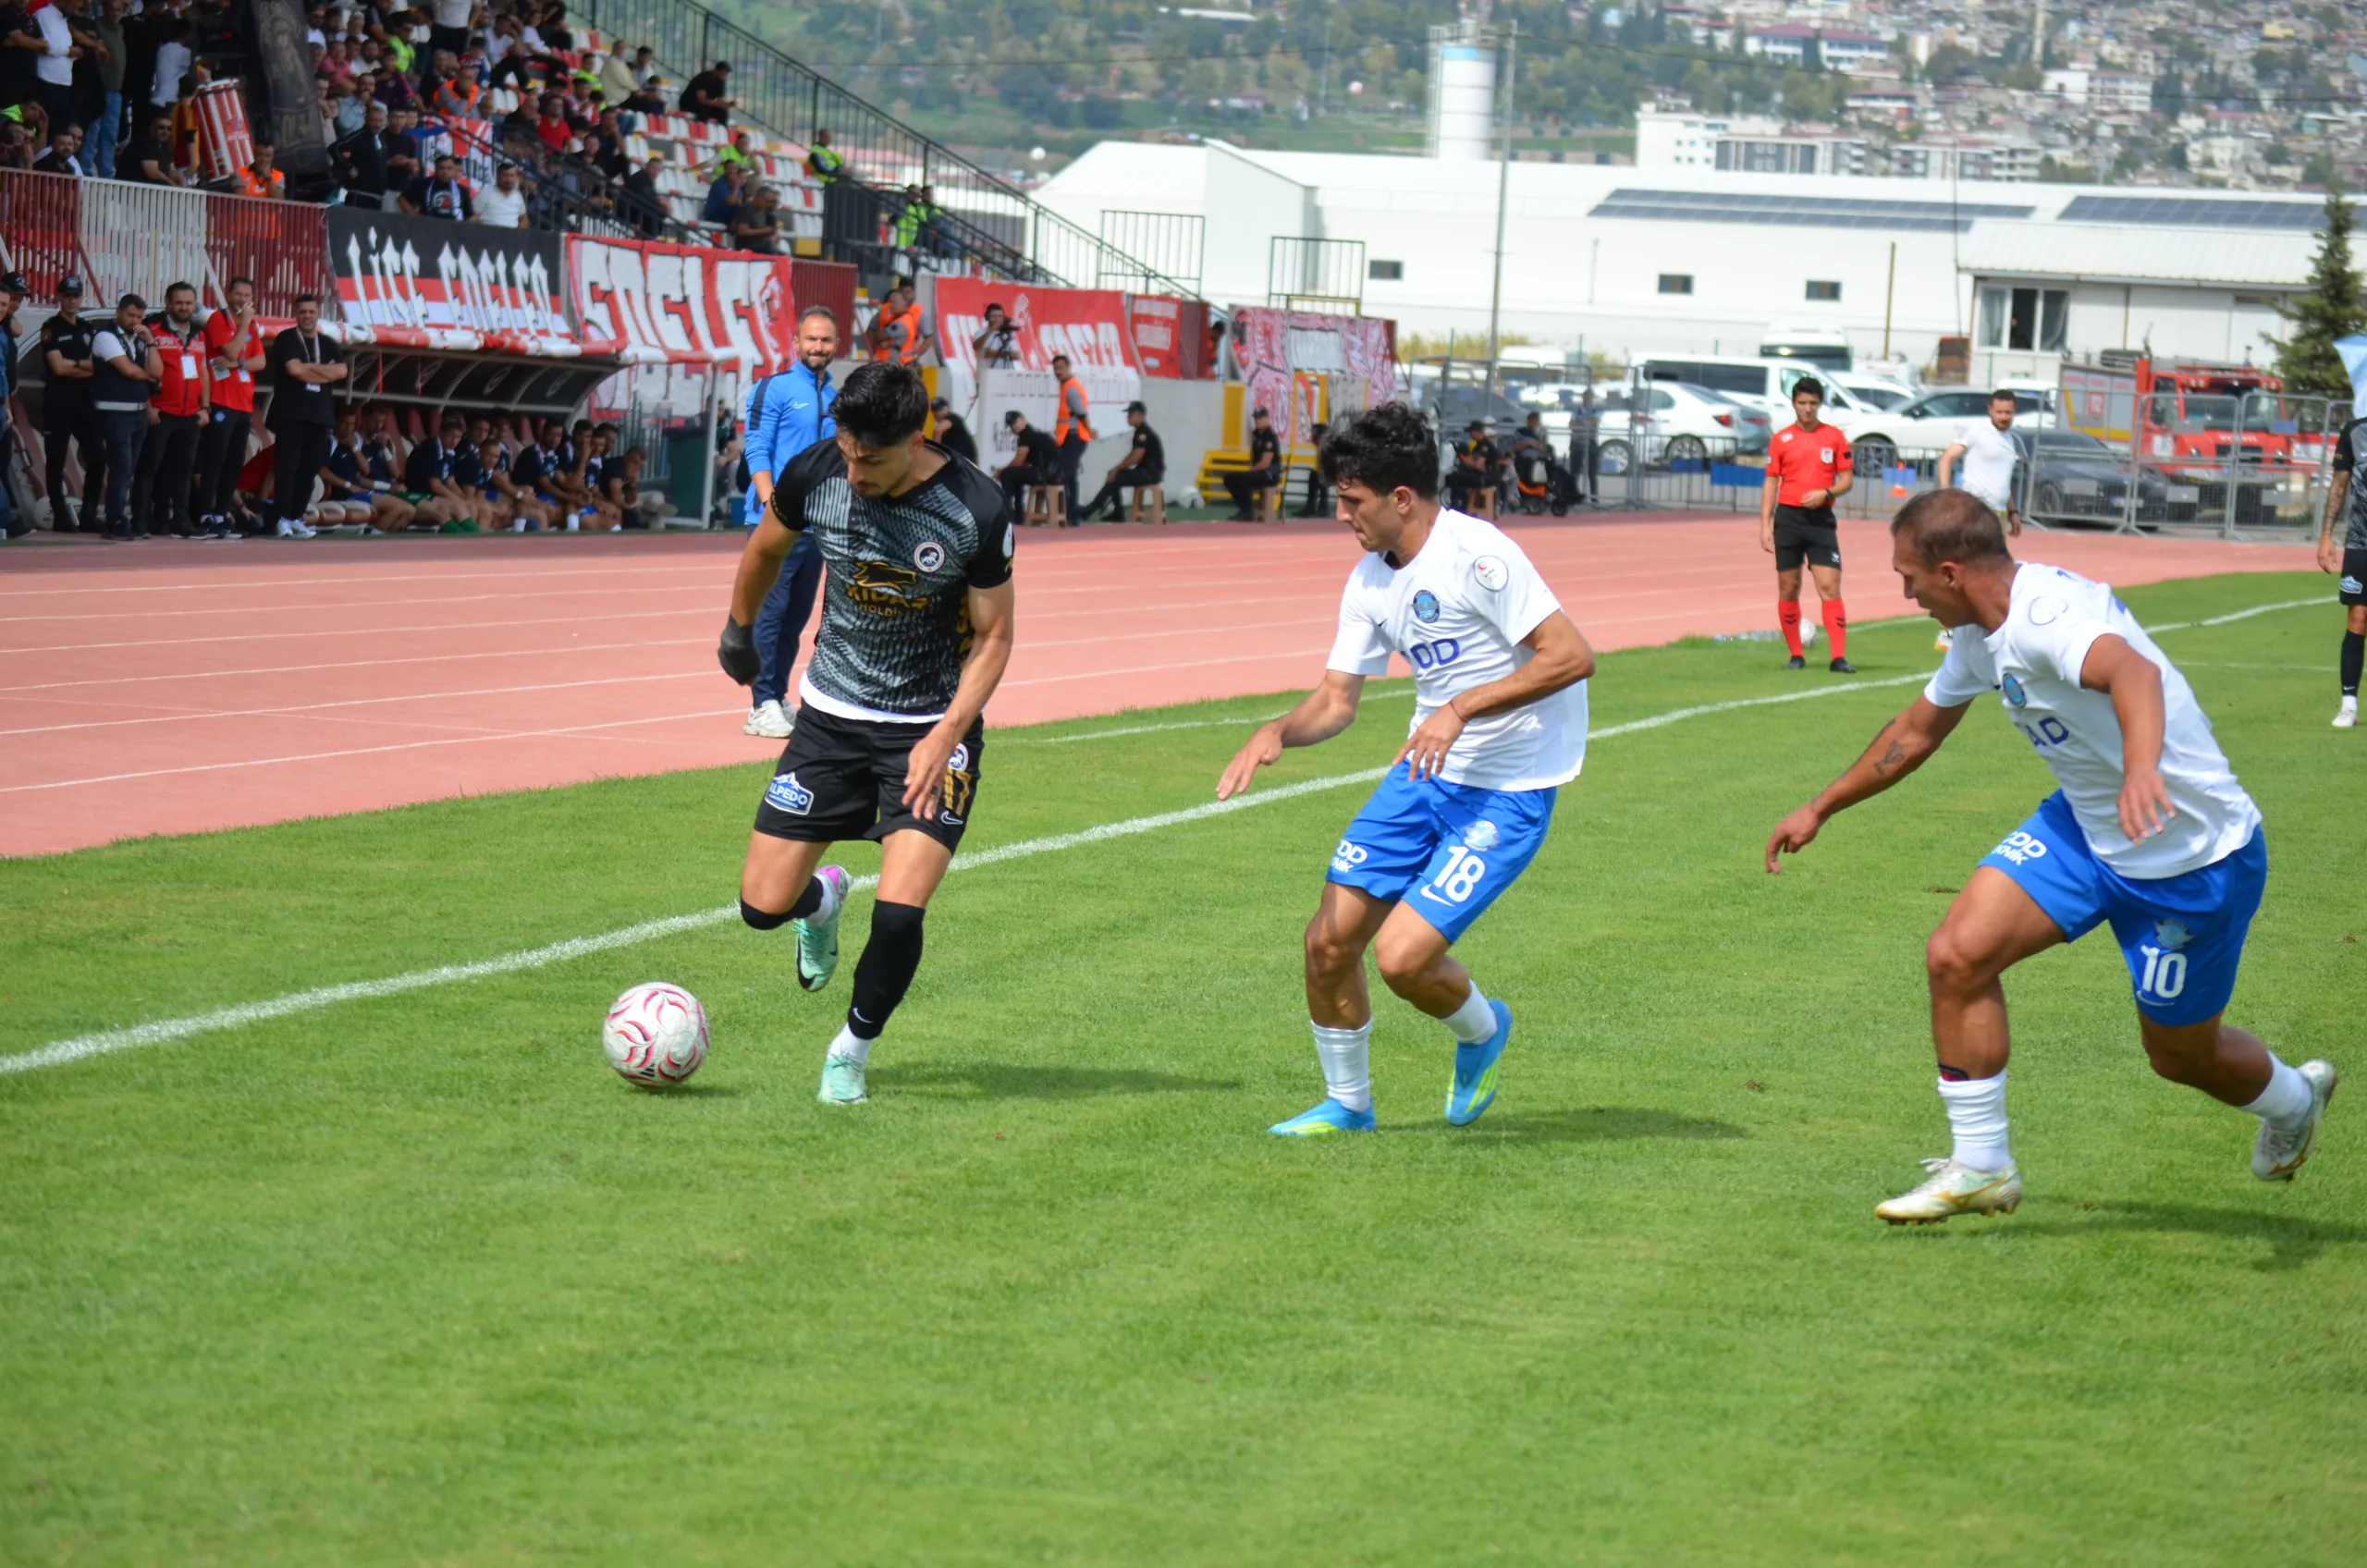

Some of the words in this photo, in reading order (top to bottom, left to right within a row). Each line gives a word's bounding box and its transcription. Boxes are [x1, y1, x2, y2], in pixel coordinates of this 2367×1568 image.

[1400, 638, 1460, 669] DD
[1433, 846, 1486, 902] 18
[2140, 944, 2188, 998] 10
